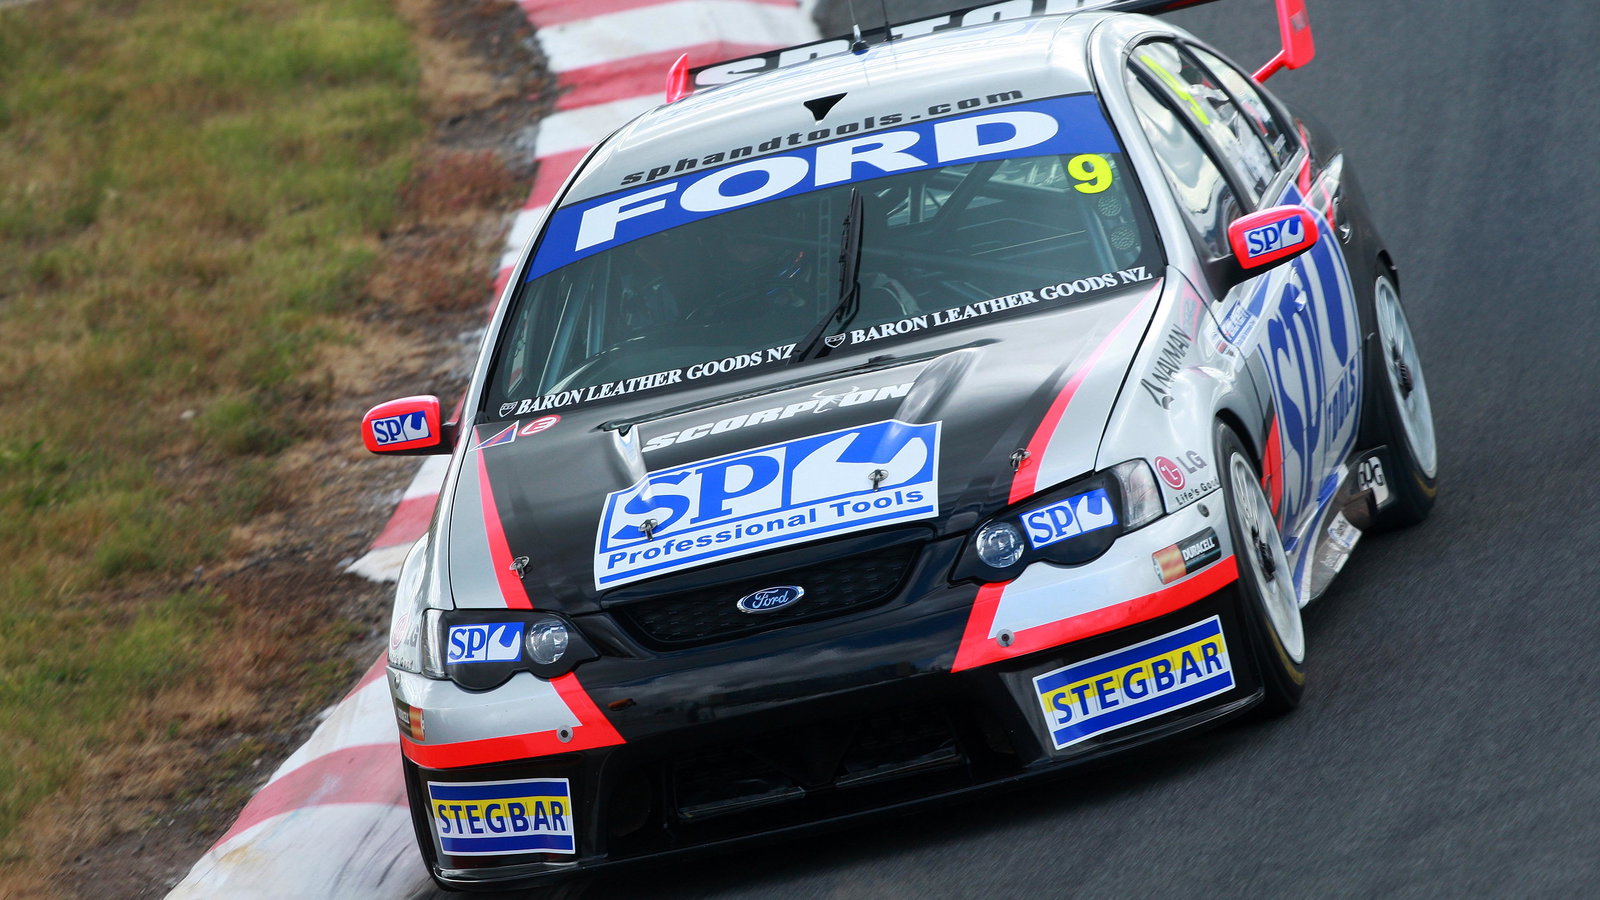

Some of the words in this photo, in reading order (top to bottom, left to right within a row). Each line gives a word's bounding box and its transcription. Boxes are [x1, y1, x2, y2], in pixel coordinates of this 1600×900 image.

[619, 89, 1022, 186] sphandtools.com
[574, 110, 1060, 253] FORD
[1067, 153, 1113, 195] 9
[1247, 224, 1279, 255] SP
[849, 314, 928, 345] BARON
[932, 290, 1039, 328] LEATHER
[1039, 272, 1119, 302] GOODS
[1120, 265, 1154, 284] NZ
[1152, 323, 1192, 389] NAVMAN
[514, 387, 586, 416] BARON
[587, 367, 685, 402] LEATHER
[686, 348, 763, 380] GOODS
[766, 342, 798, 364] NZ
[374, 419, 402, 443] SP
[641, 381, 916, 453] SCORPION
[1175, 449, 1208, 475] LG
[610, 453, 781, 541] SP
[1175, 488, 1200, 506] Life's
[607, 507, 817, 570] Professional
[829, 488, 925, 518] Tools
[1027, 504, 1074, 545] SP
[1181, 536, 1216, 561] DURACELL
[752, 589, 789, 609] Ford
[449, 627, 487, 660] SP
[1051, 640, 1224, 725] STEGBAR
[437, 800, 567, 835] STEGBAR
